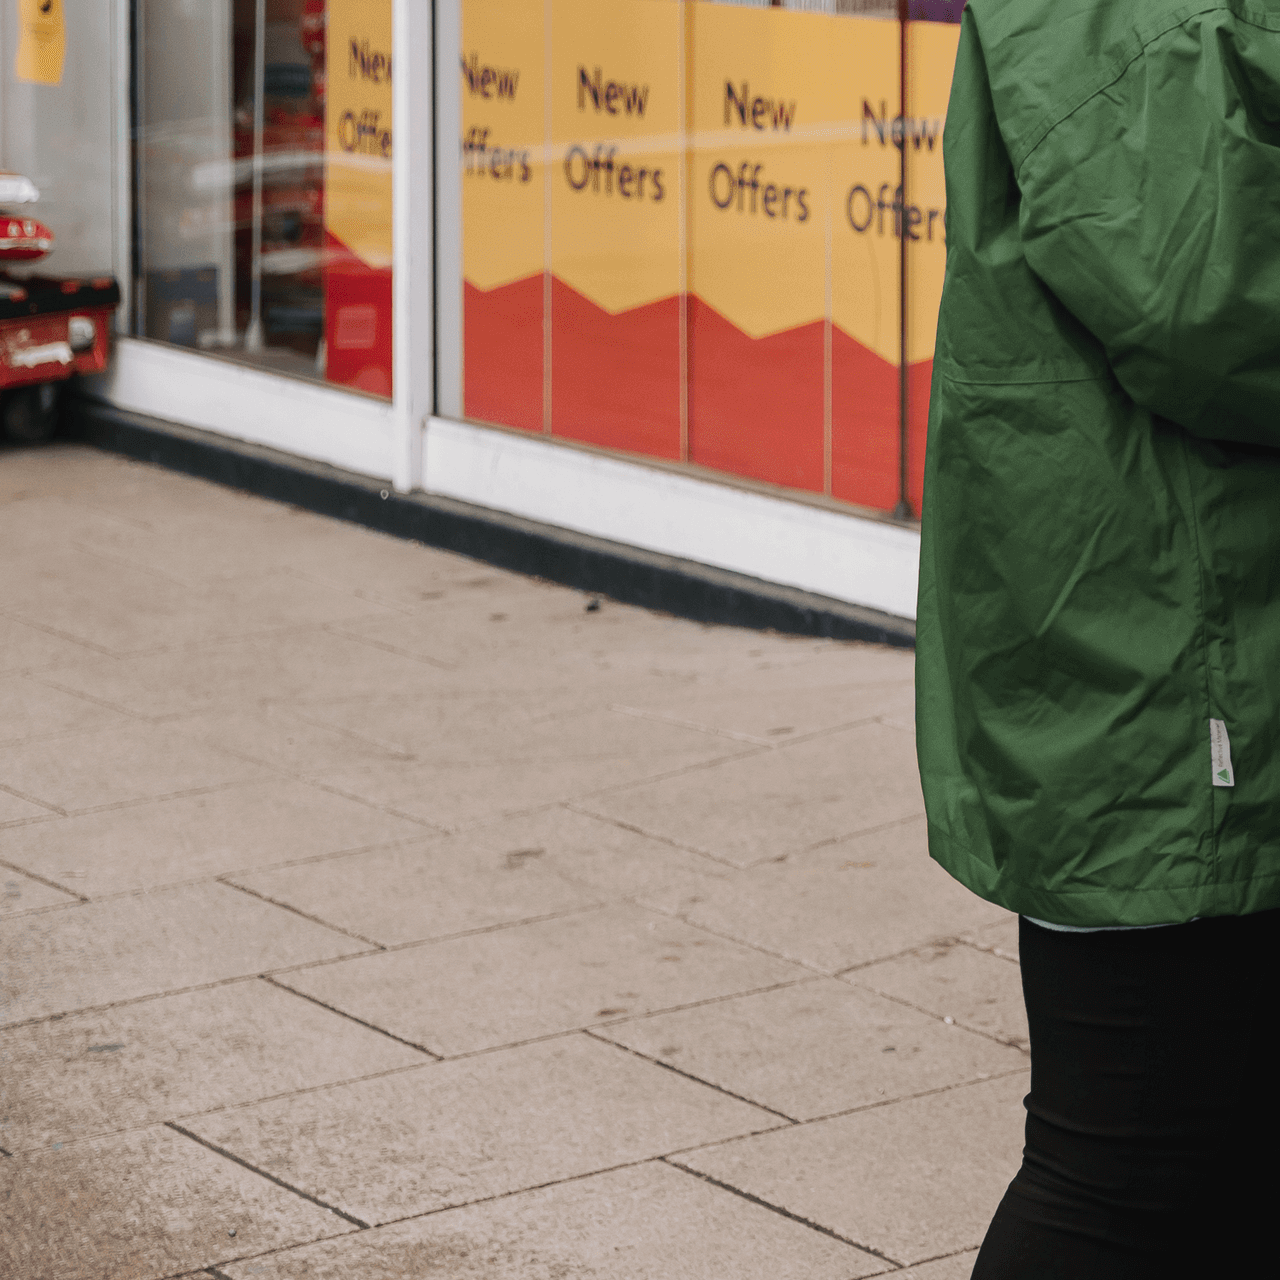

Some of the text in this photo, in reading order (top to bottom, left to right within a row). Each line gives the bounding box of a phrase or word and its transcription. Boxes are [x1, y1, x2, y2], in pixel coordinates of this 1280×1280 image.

[348, 36, 392, 84] Ne
[577, 65, 650, 119] New
[723, 77, 797, 134] New
[860, 96, 940, 151] New
[460, 125, 532, 183] ffers
[564, 144, 665, 202] Offers
[709, 160, 811, 223] Offers
